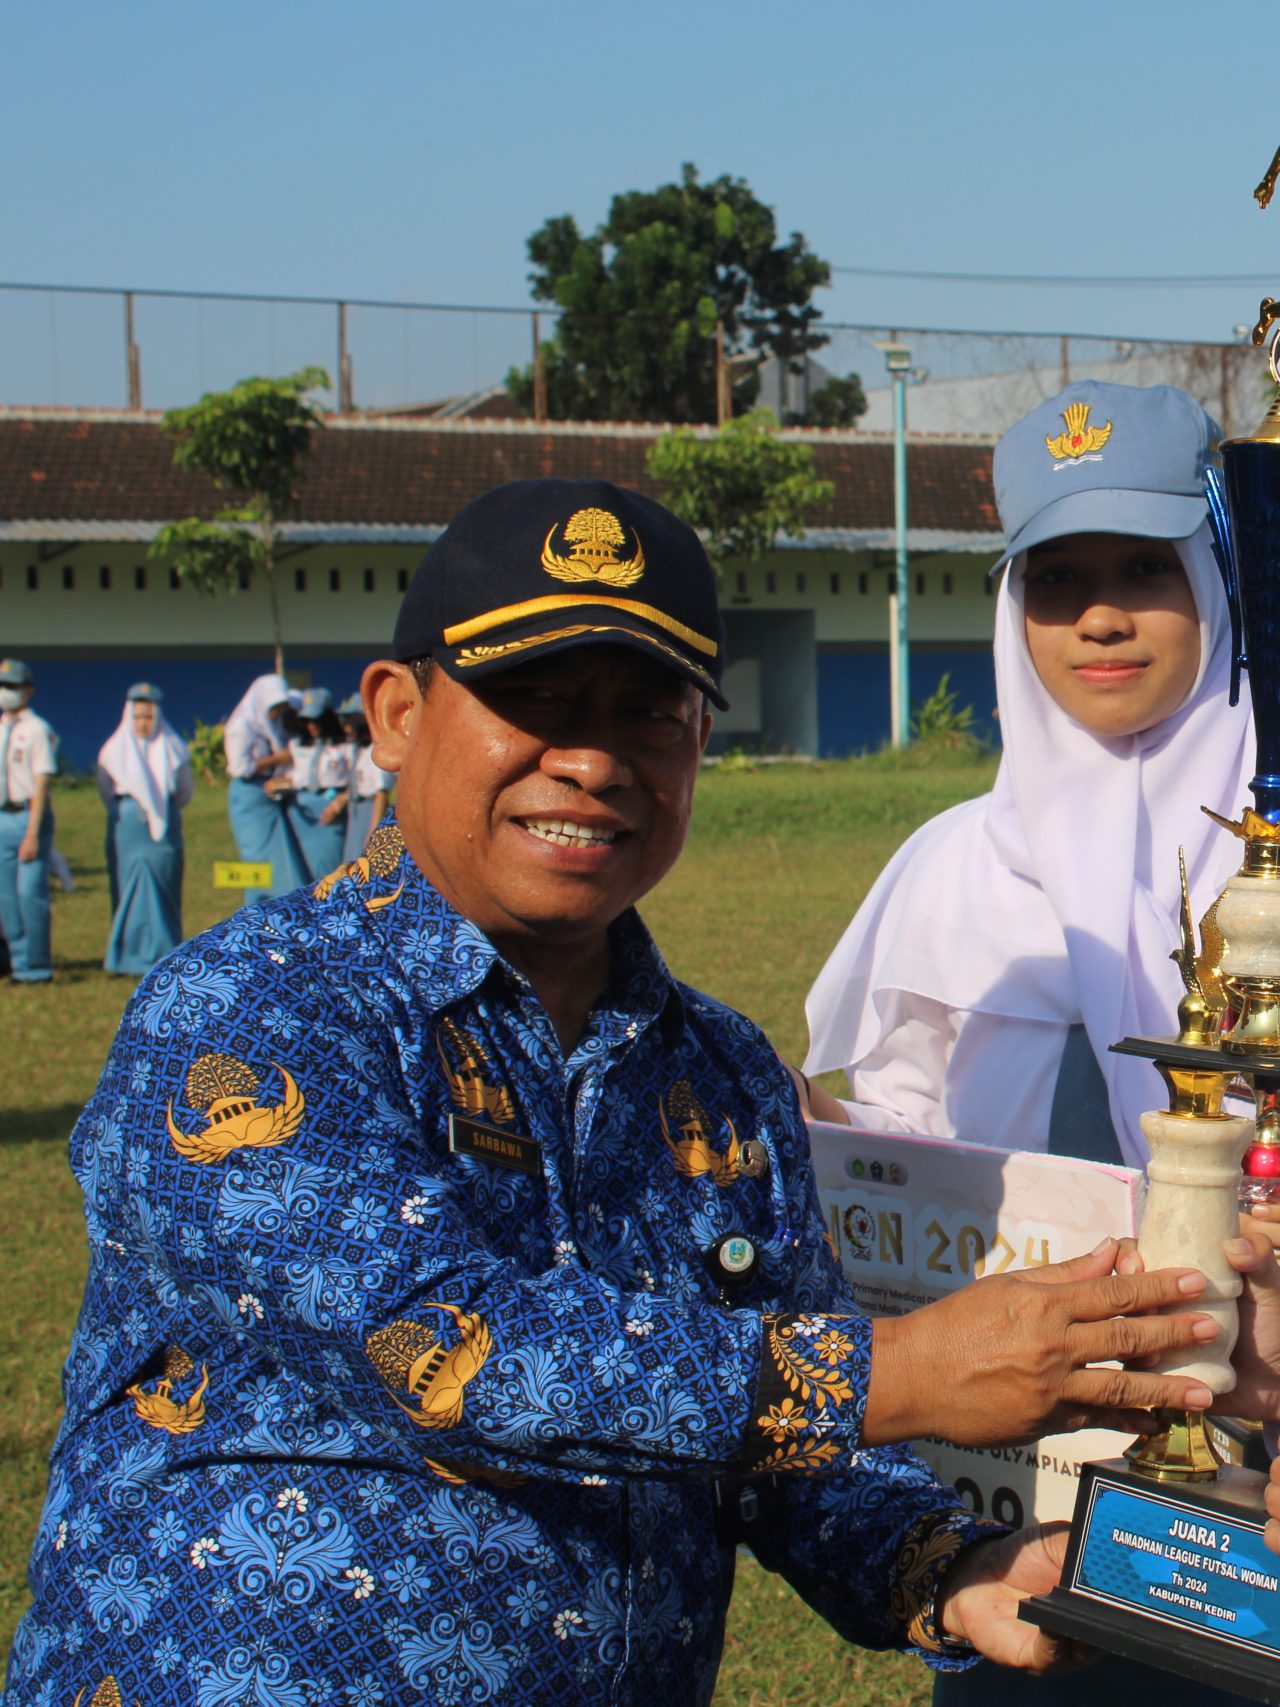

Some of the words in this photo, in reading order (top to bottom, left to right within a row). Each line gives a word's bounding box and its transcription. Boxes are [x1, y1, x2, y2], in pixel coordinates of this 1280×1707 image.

[472, 1132, 523, 1159] SARBAWA
[923, 1219, 1050, 1276] 2024
[853, 1281, 888, 1299] Primary
[889, 1288, 926, 1304] Medical
[878, 1303, 903, 1315] Malik
[989, 1447, 1082, 1478] OLYMPIAD
[1168, 1518, 1217, 1549] JUARA
[1219, 1533, 1231, 1552] 2
[1112, 1528, 1163, 1556] RAMADHAN
[1164, 1544, 1201, 1568] LEAGUE
[1202, 1557, 1239, 1580] FUTSAL
[1241, 1567, 1279, 1592] WOMAN
[1171, 1572, 1183, 1586] Th
[1185, 1576, 1208, 1594] 2024
[1149, 1586, 1203, 1612] KABUPATEN
[1204, 1602, 1236, 1622] KEDIRI
